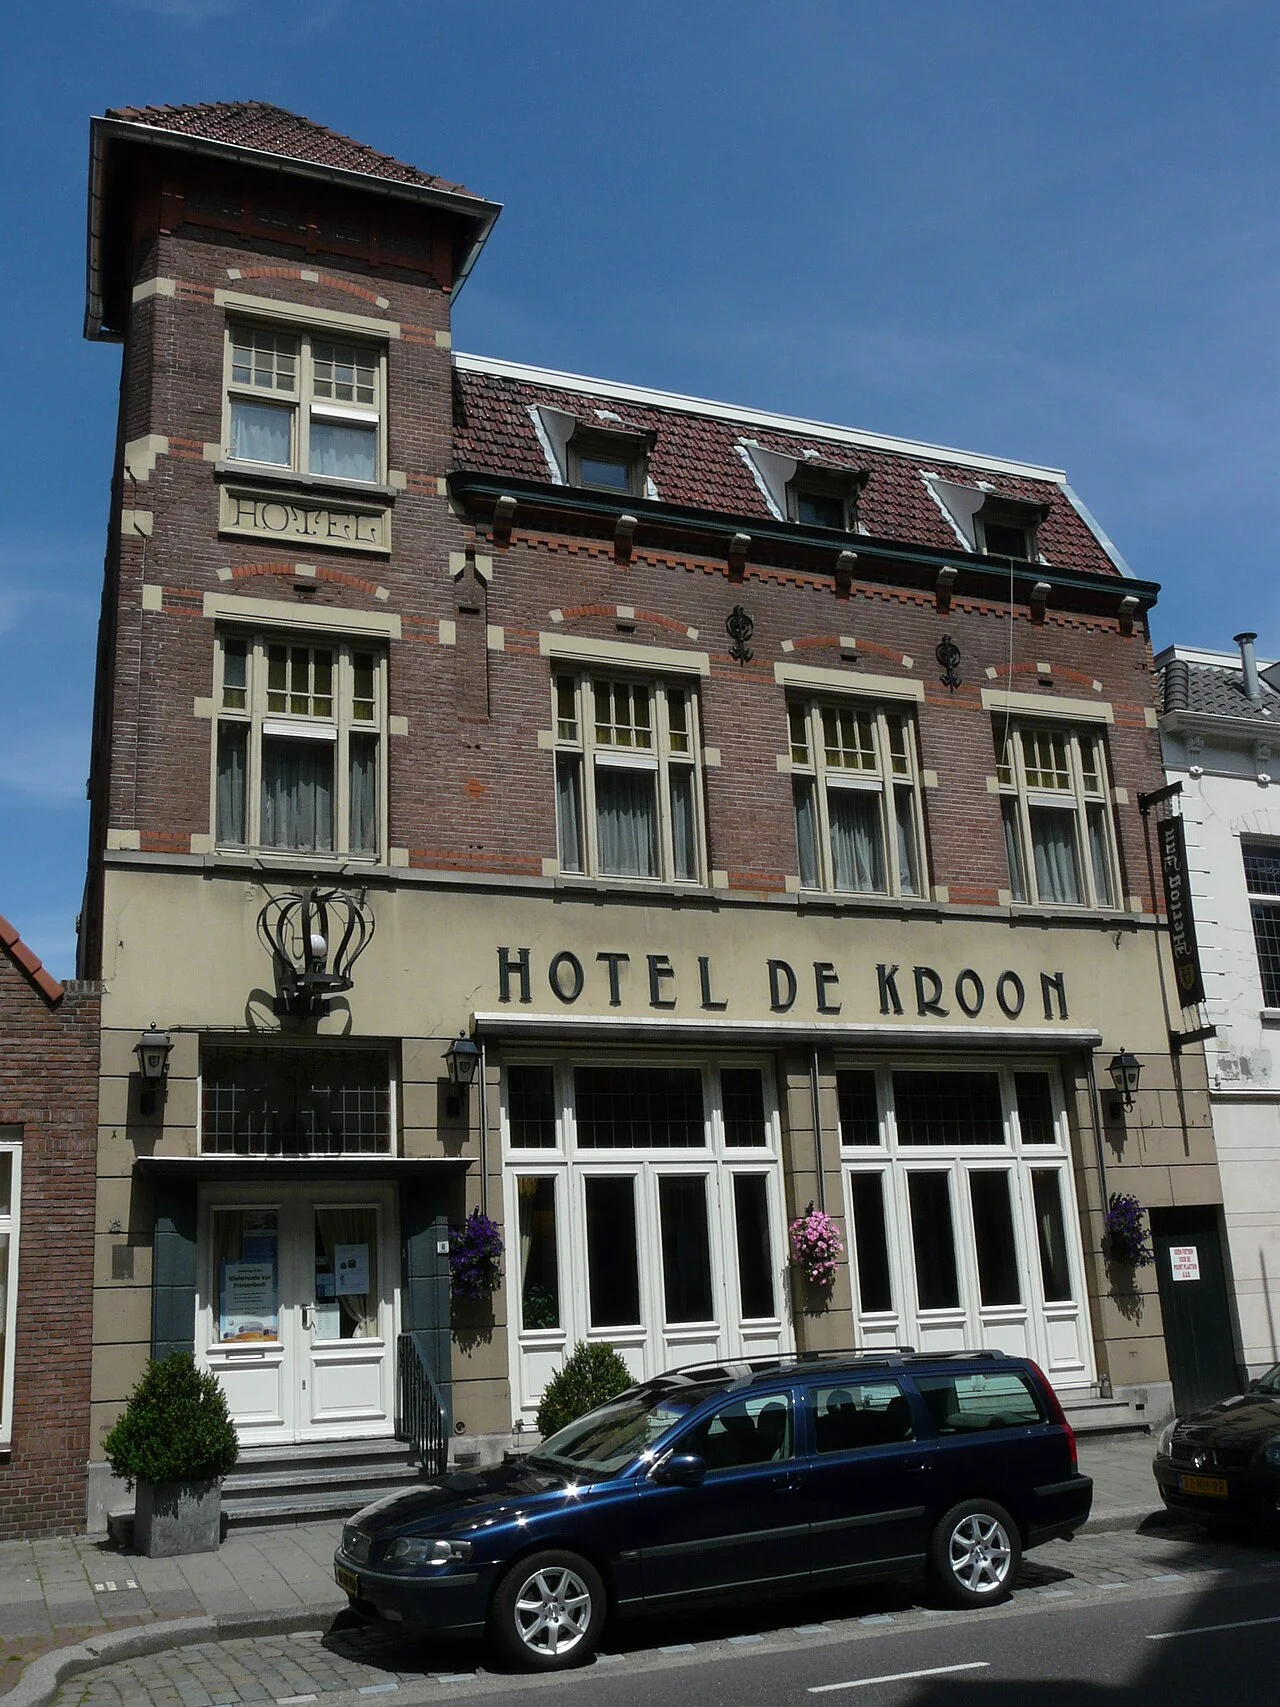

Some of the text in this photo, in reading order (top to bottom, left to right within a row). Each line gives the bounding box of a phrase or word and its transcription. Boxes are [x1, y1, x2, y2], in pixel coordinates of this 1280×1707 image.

[231, 498, 377, 543] HOTEL
[1163, 828, 1192, 959] Hertog Jan
[496, 946, 1069, 1021] HOTEL DE KROON
